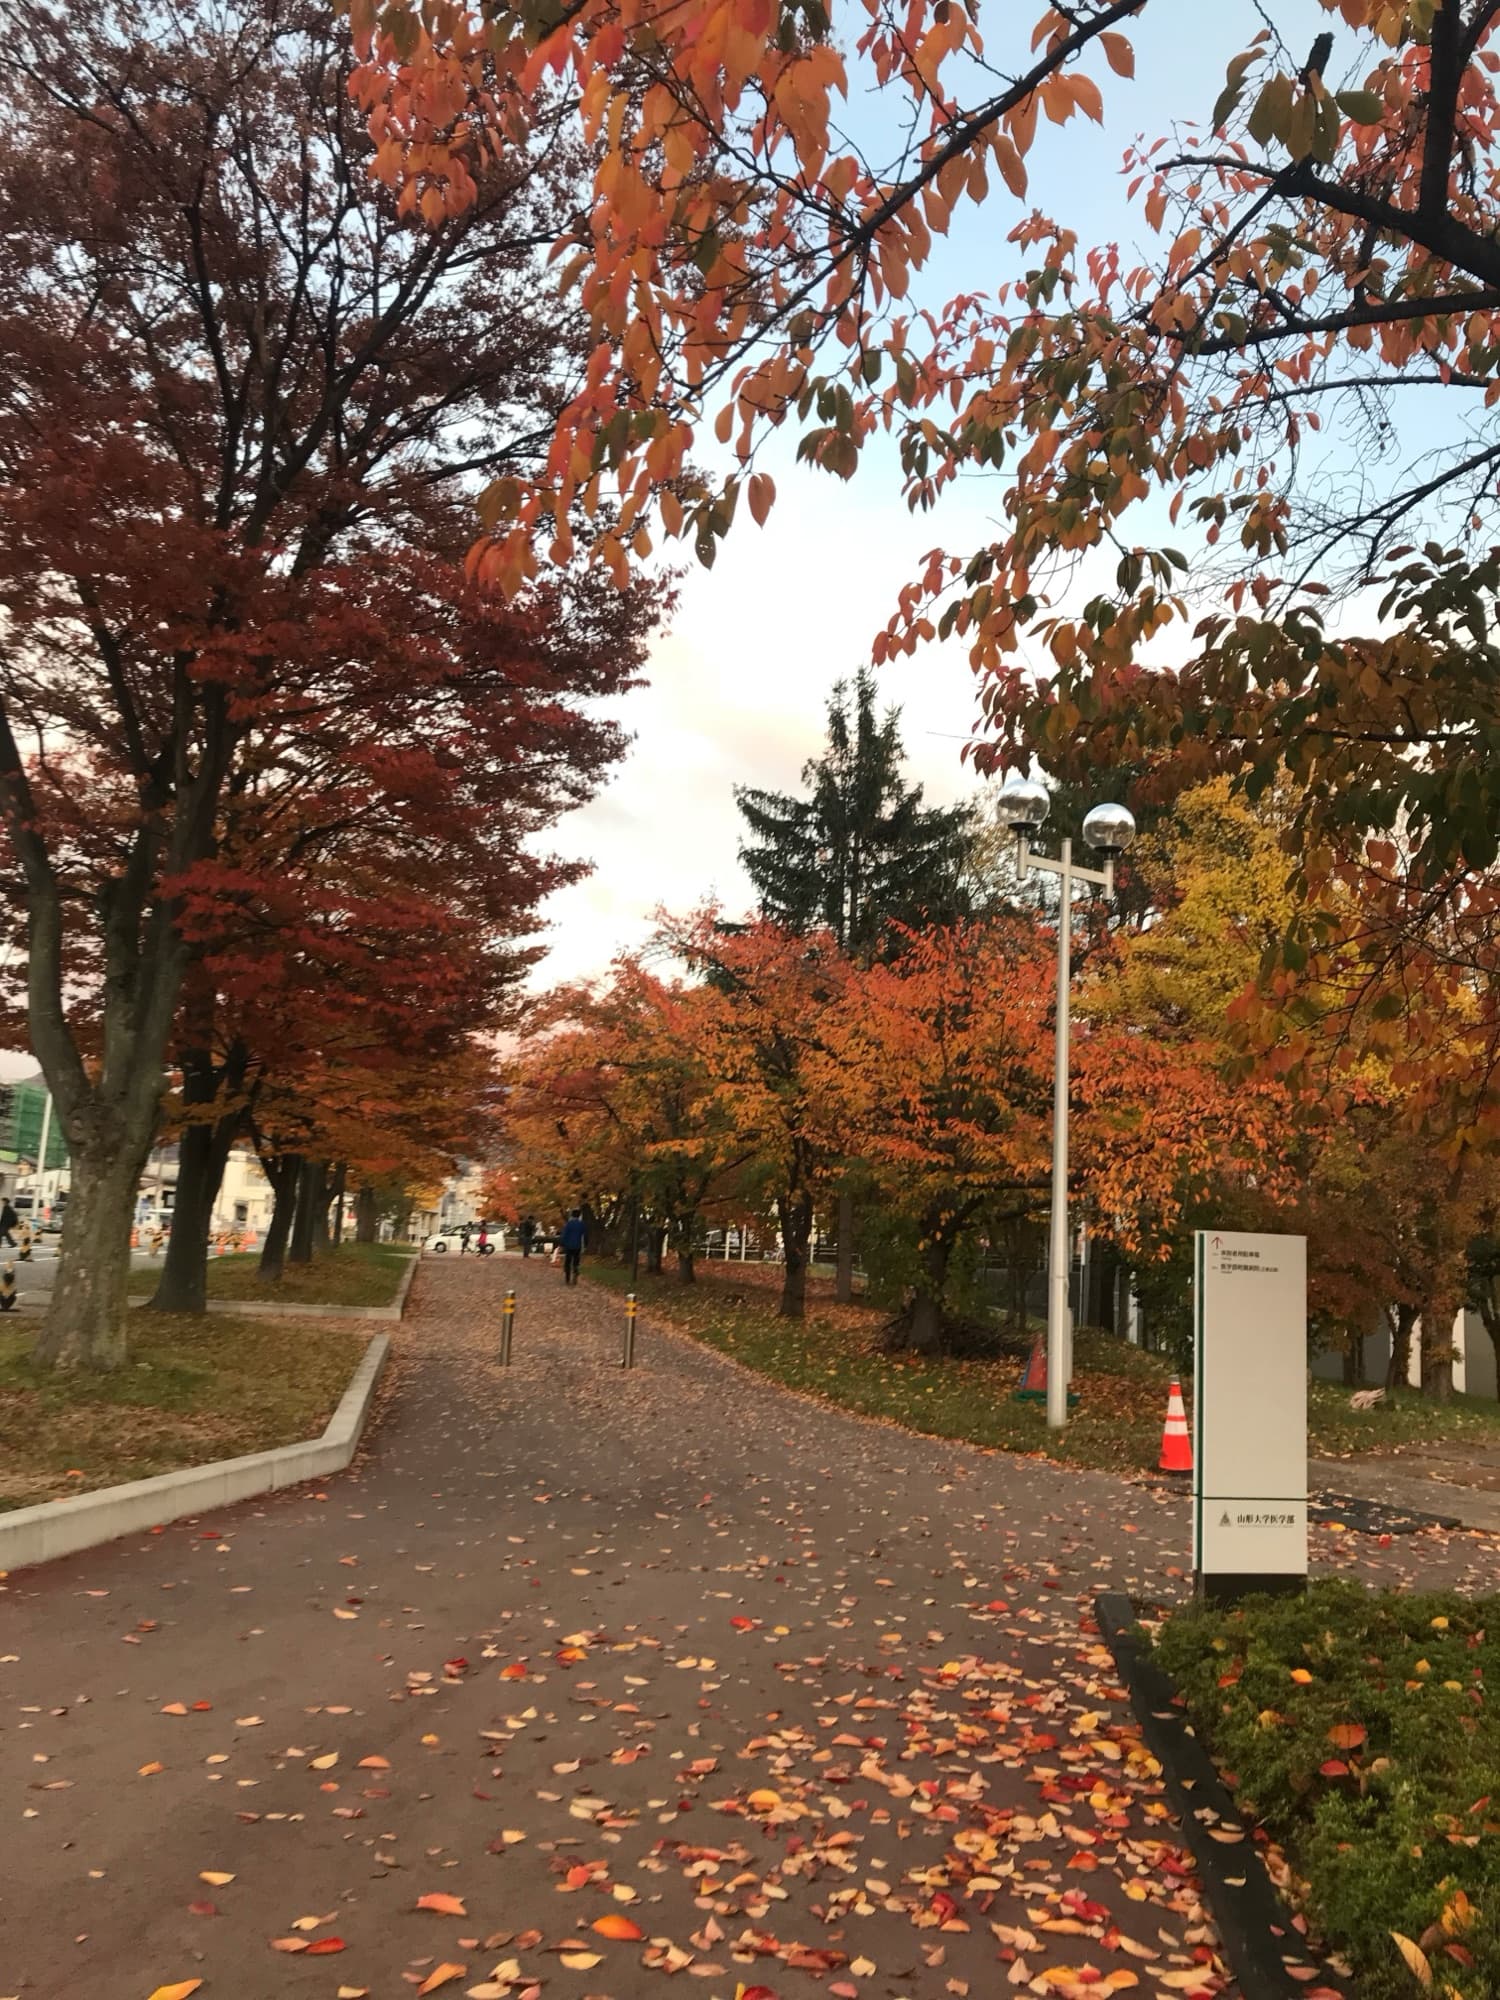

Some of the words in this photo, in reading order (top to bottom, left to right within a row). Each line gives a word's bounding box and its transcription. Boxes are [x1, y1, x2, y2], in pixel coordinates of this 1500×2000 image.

[1237, 1514, 1295, 1524] 山形大学医学部
